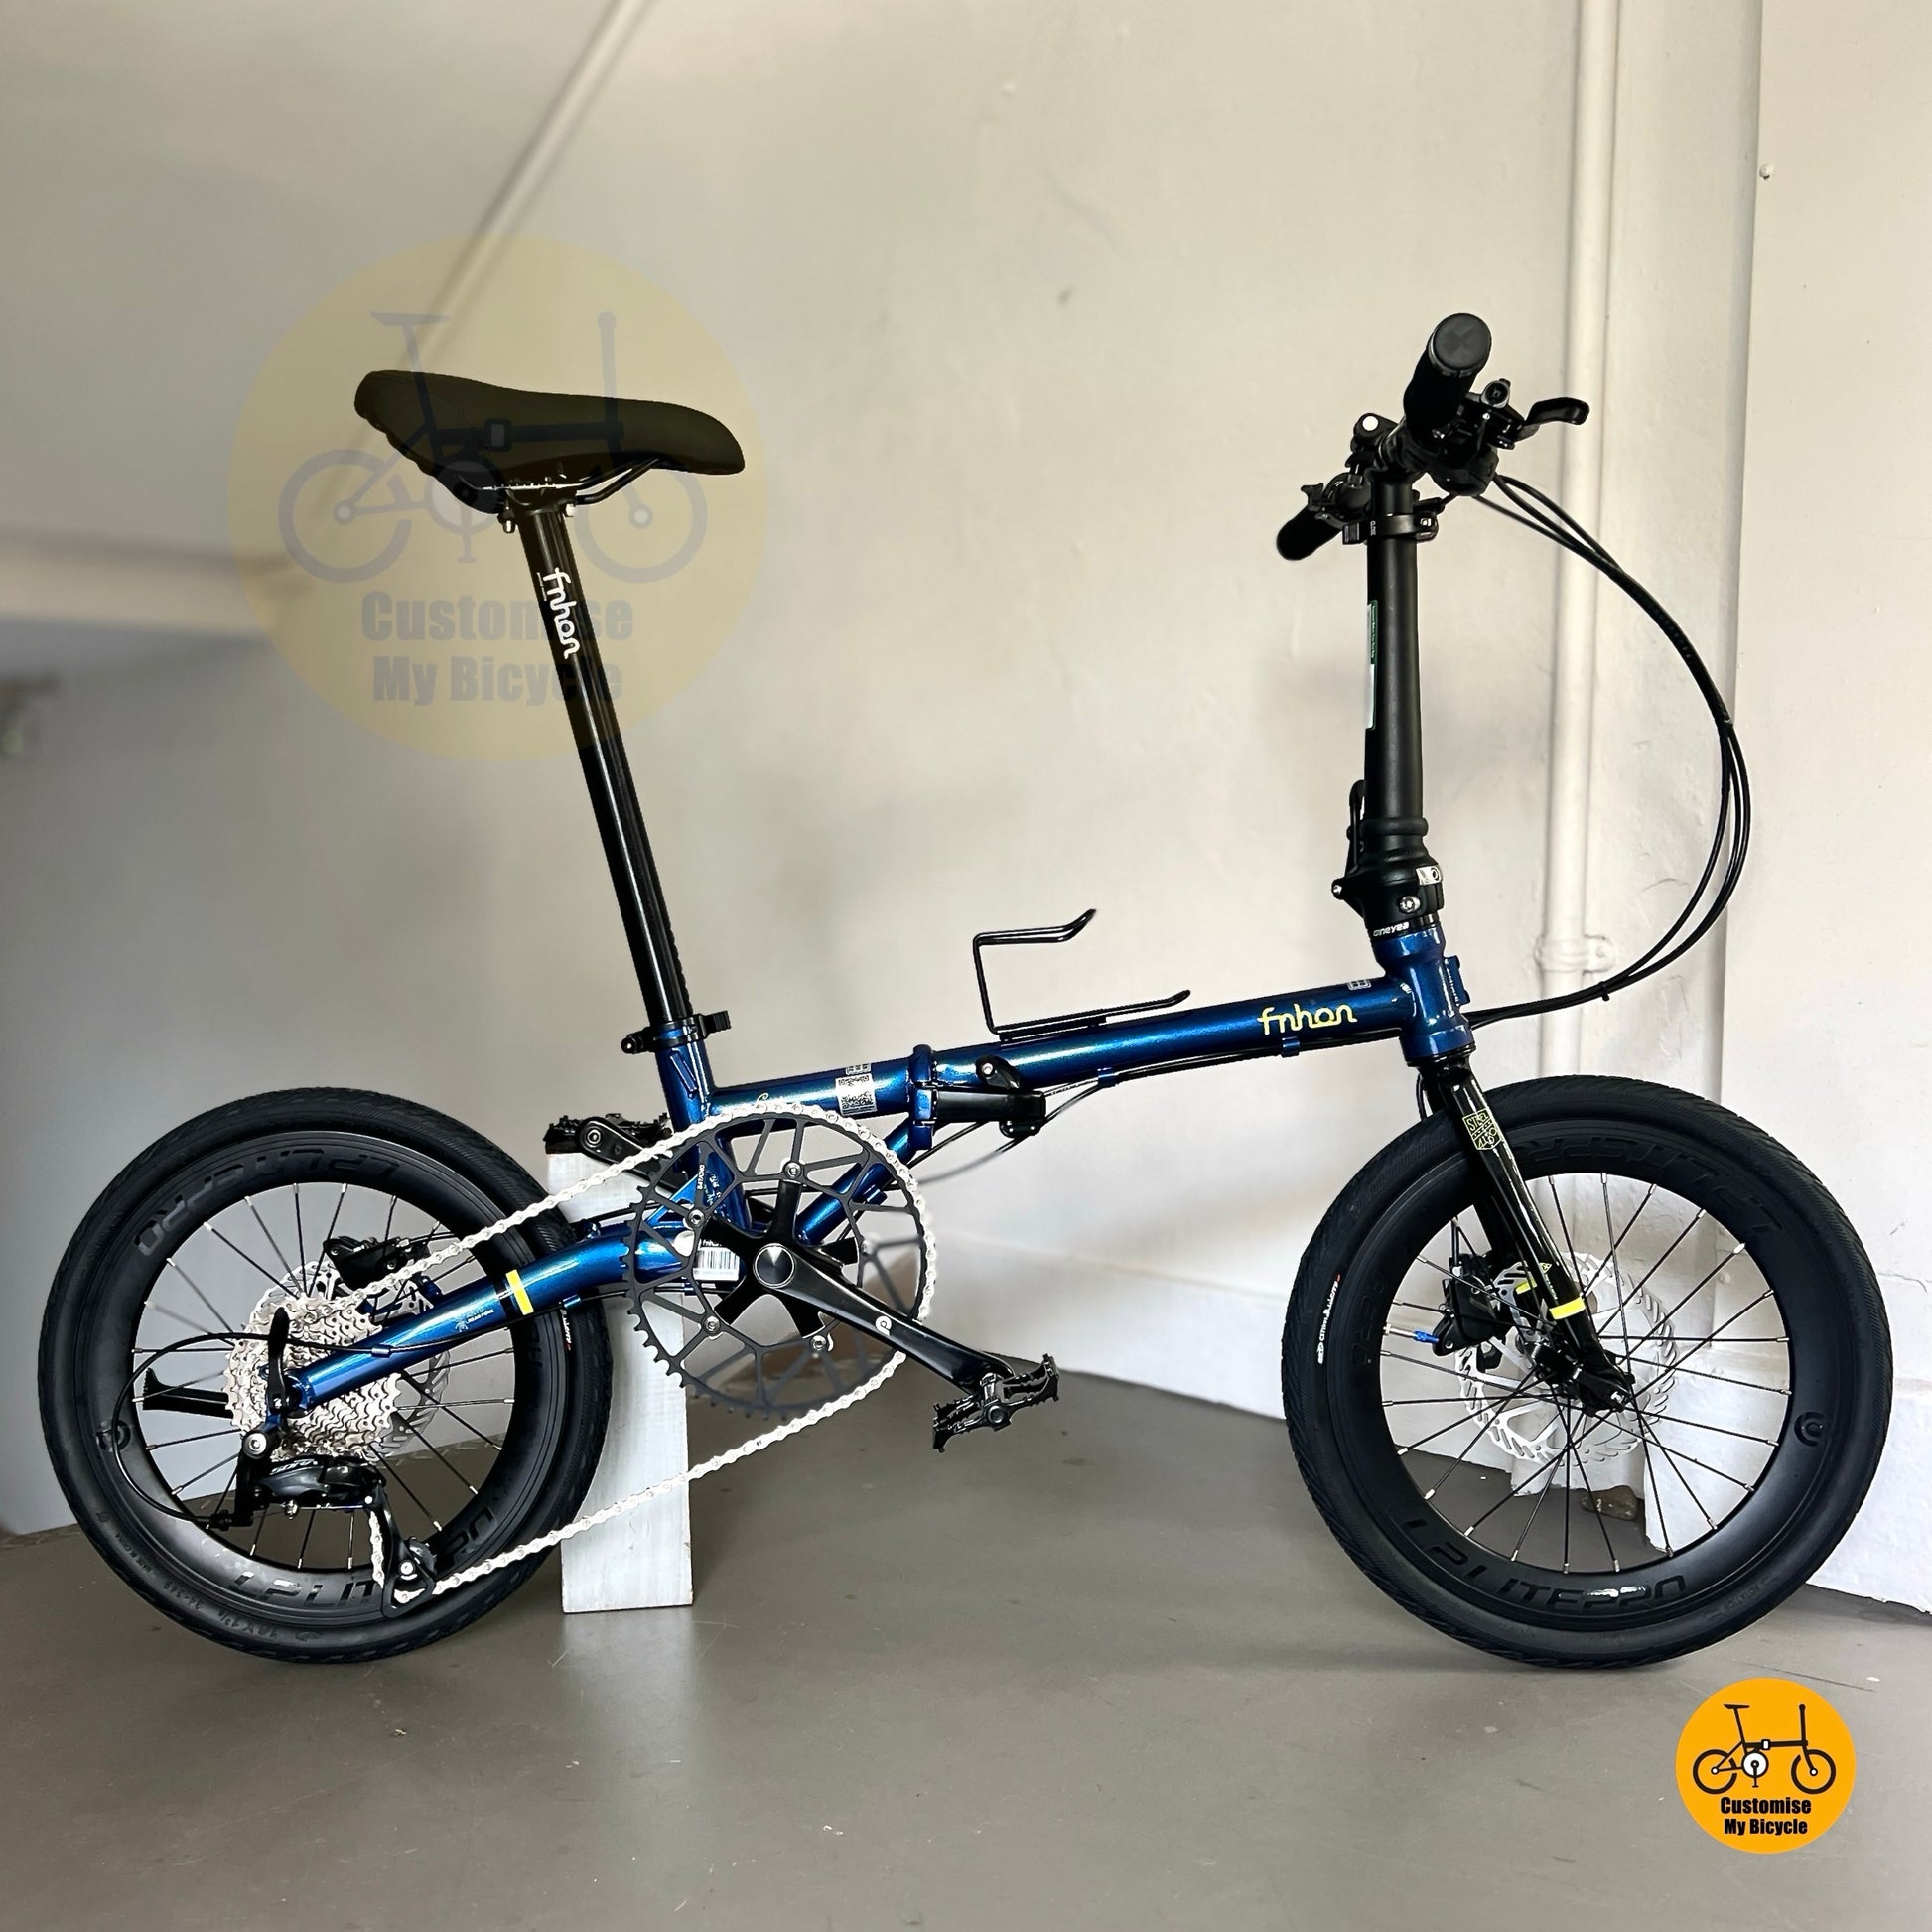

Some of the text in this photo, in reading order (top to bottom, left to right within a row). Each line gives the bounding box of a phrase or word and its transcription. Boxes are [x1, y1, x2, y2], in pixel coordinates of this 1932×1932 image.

[543, 566, 581, 660] fnhon
[1257, 1004, 1357, 1036] fnhon
[1466, 1112, 1489, 1131] STEEL
